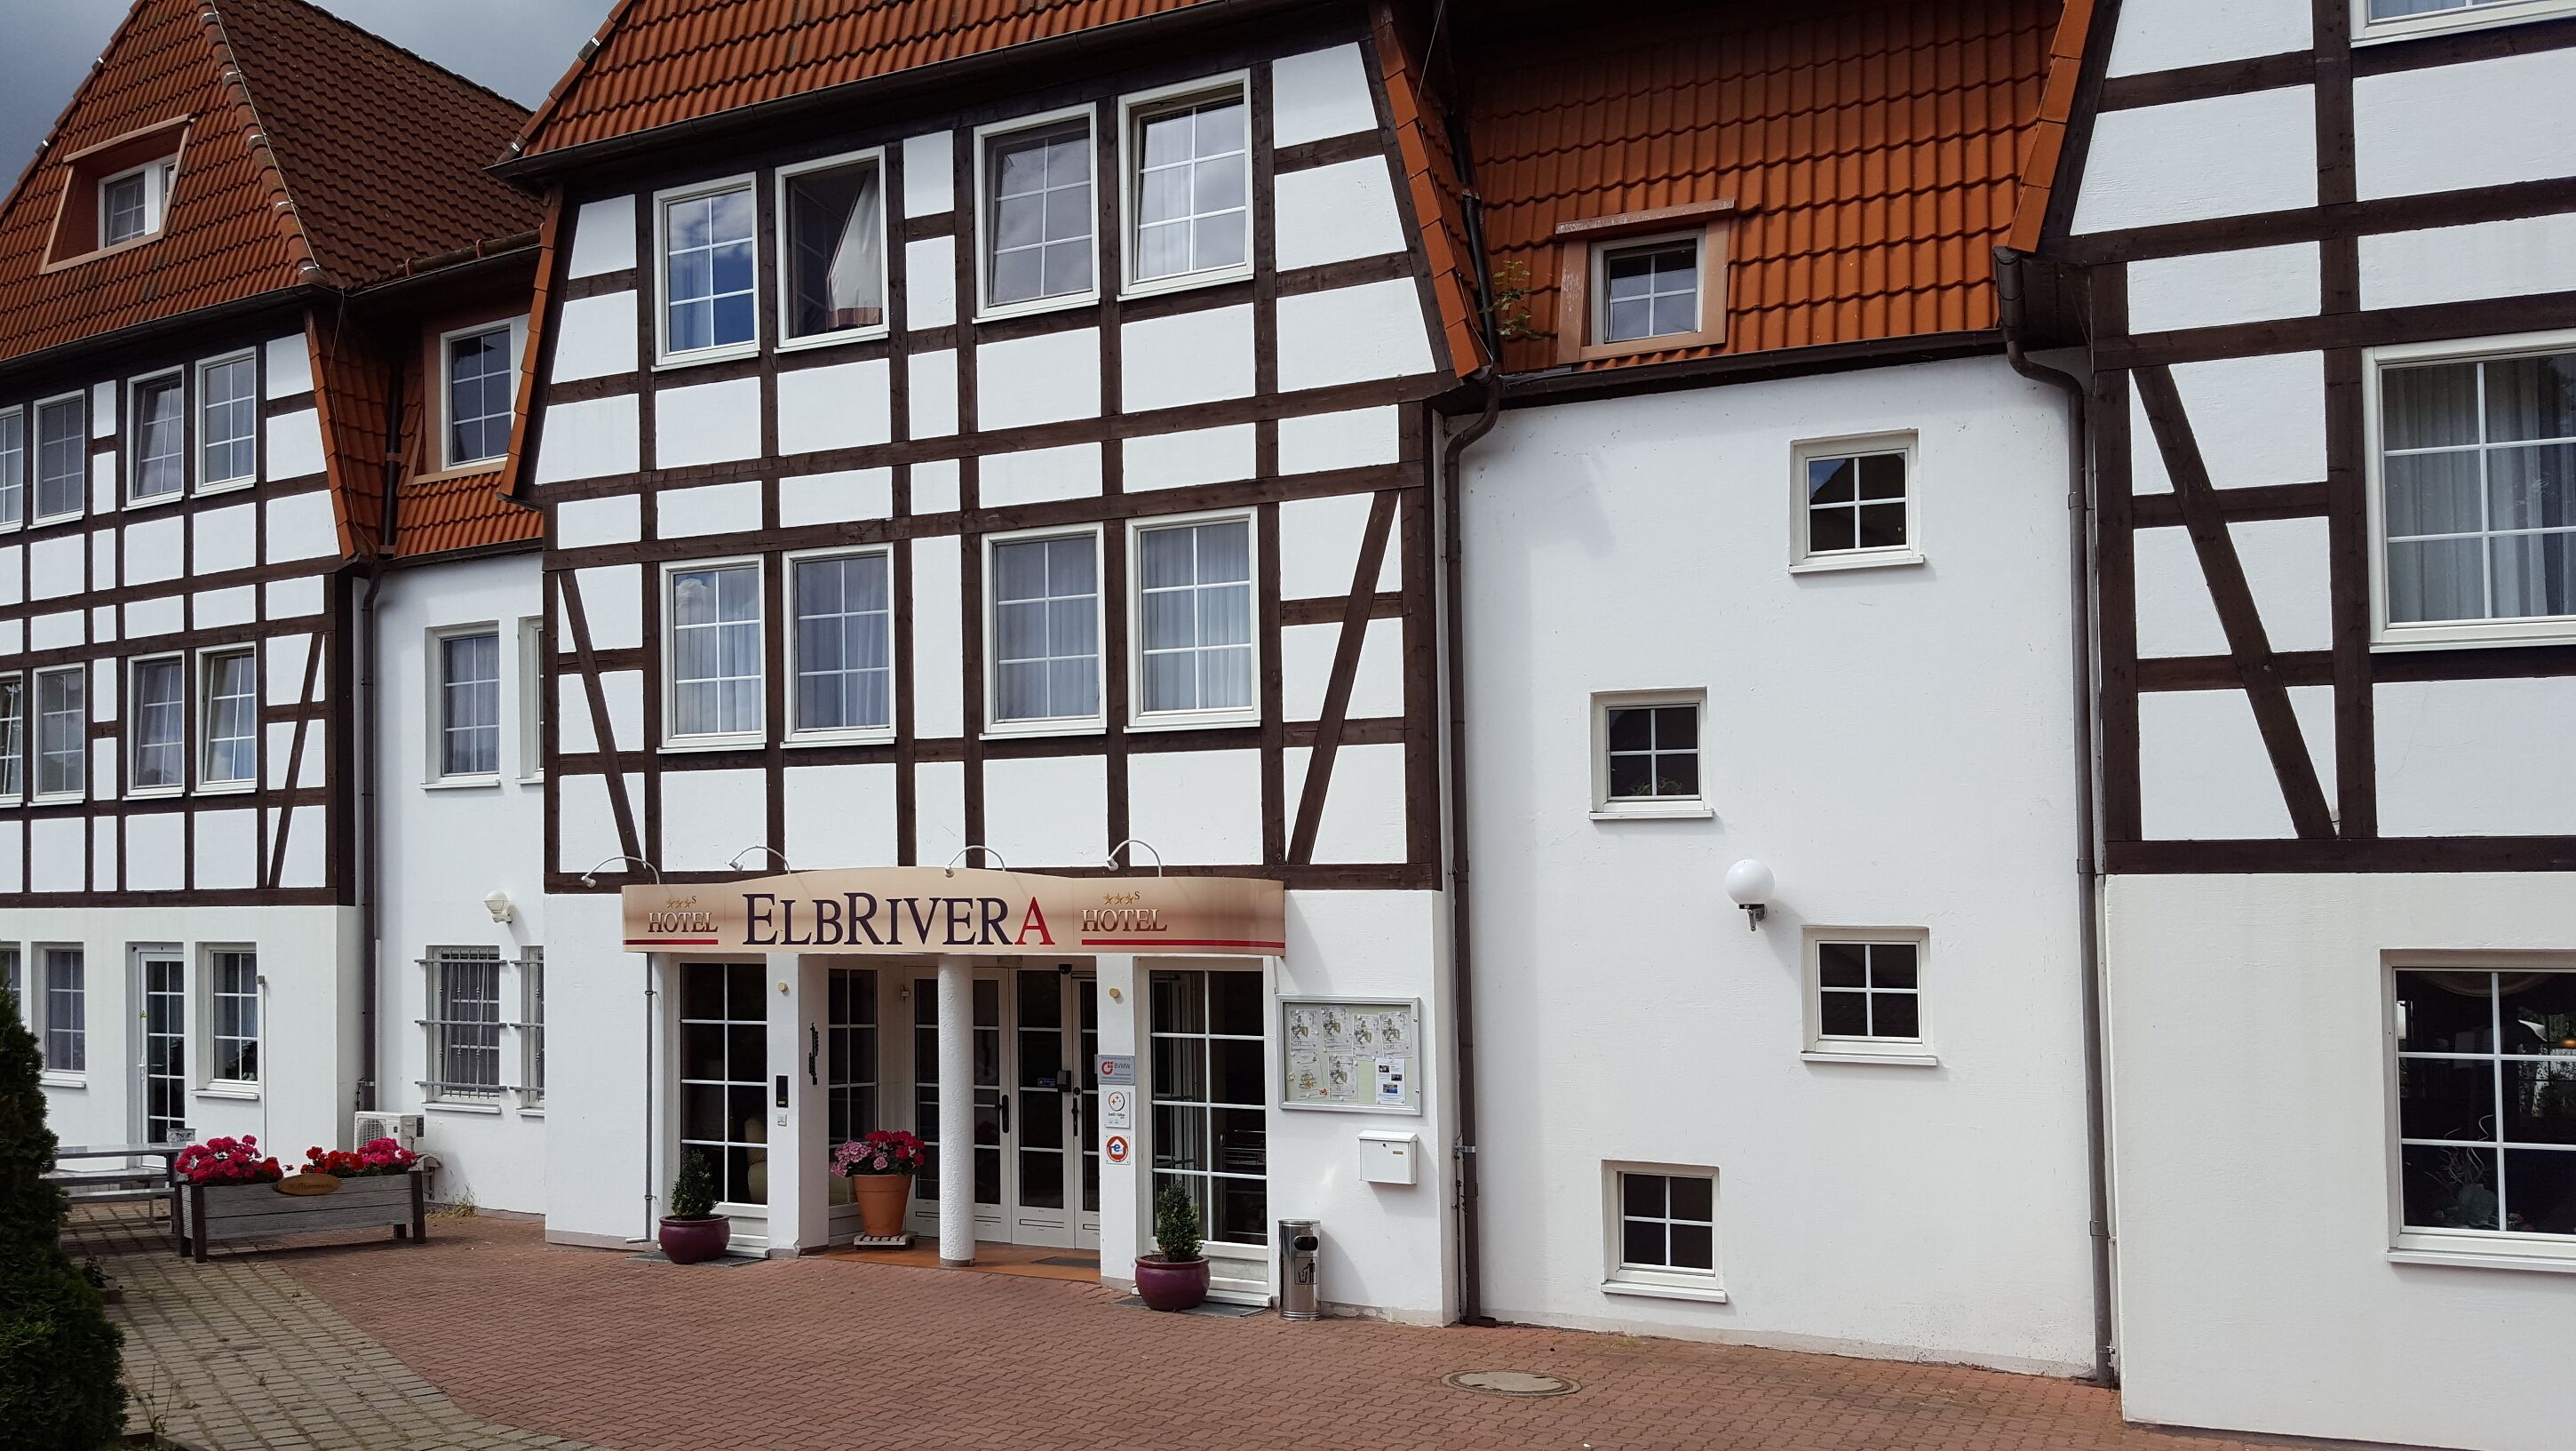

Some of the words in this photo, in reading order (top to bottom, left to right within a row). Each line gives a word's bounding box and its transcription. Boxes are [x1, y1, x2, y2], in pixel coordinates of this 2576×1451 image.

[691, 895, 697, 905] S
[1134, 890, 1141, 900] S
[648, 911, 719, 933] HOTEL
[742, 891, 1056, 945] ELBRIVERA
[1081, 908, 1168, 932] HOTEL
